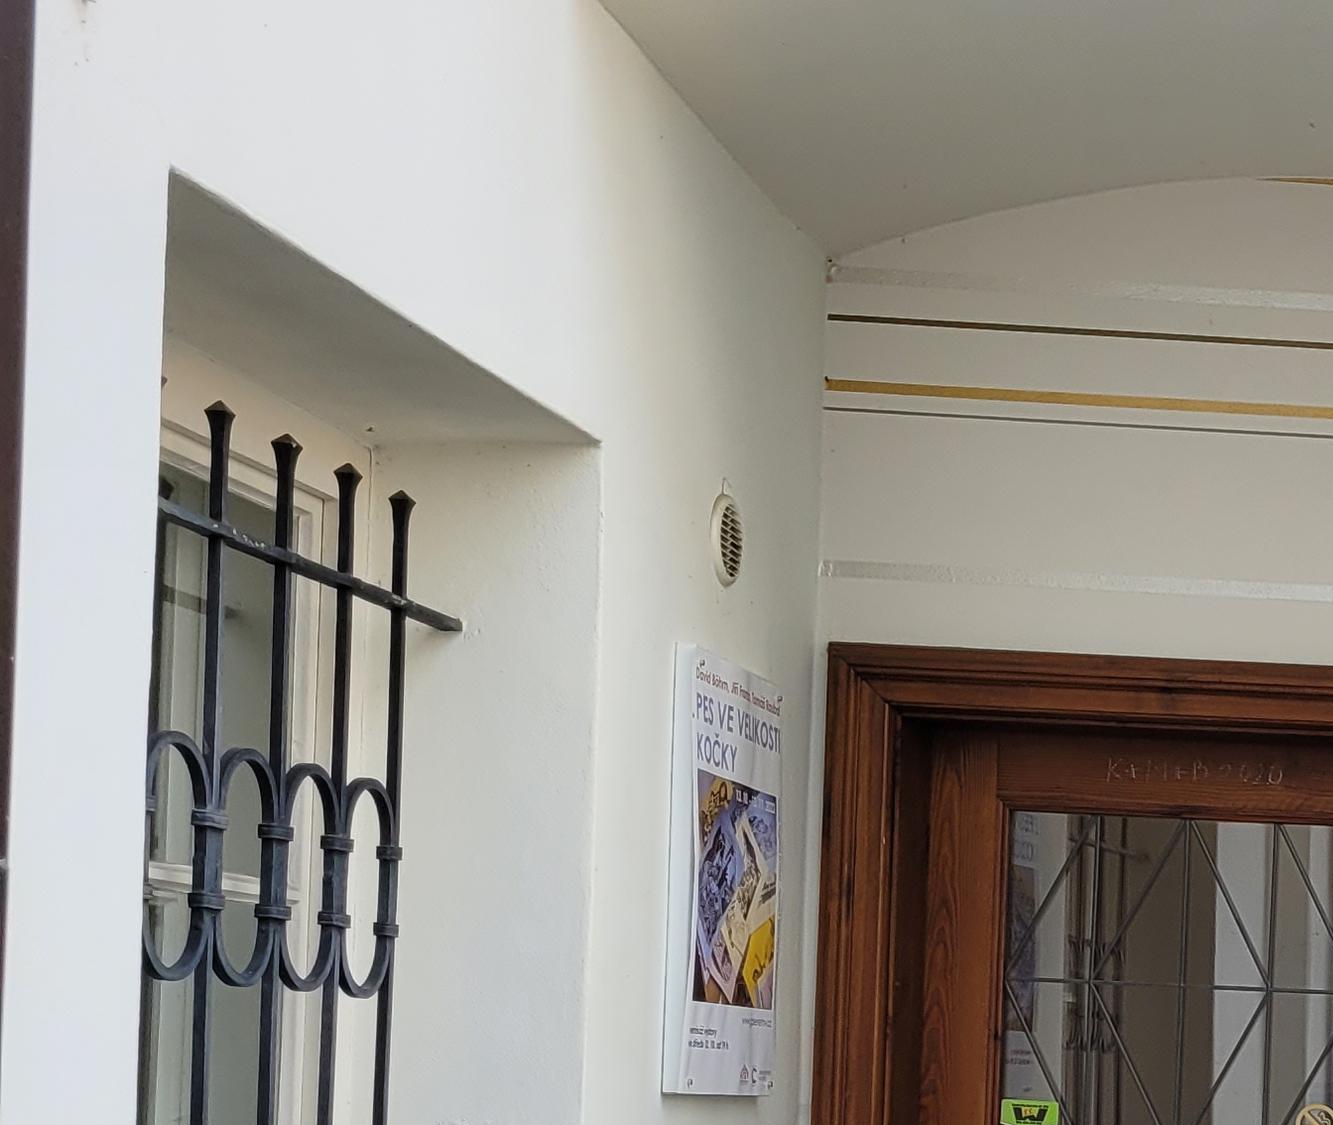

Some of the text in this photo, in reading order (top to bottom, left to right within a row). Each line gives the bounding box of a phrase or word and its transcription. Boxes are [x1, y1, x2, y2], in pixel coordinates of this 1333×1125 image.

[696, 693, 714, 726] PES
[718, 701, 734, 733] VE
[737, 709, 782, 754] VELIKOSTI
[696, 732, 738, 773] KOČKY
